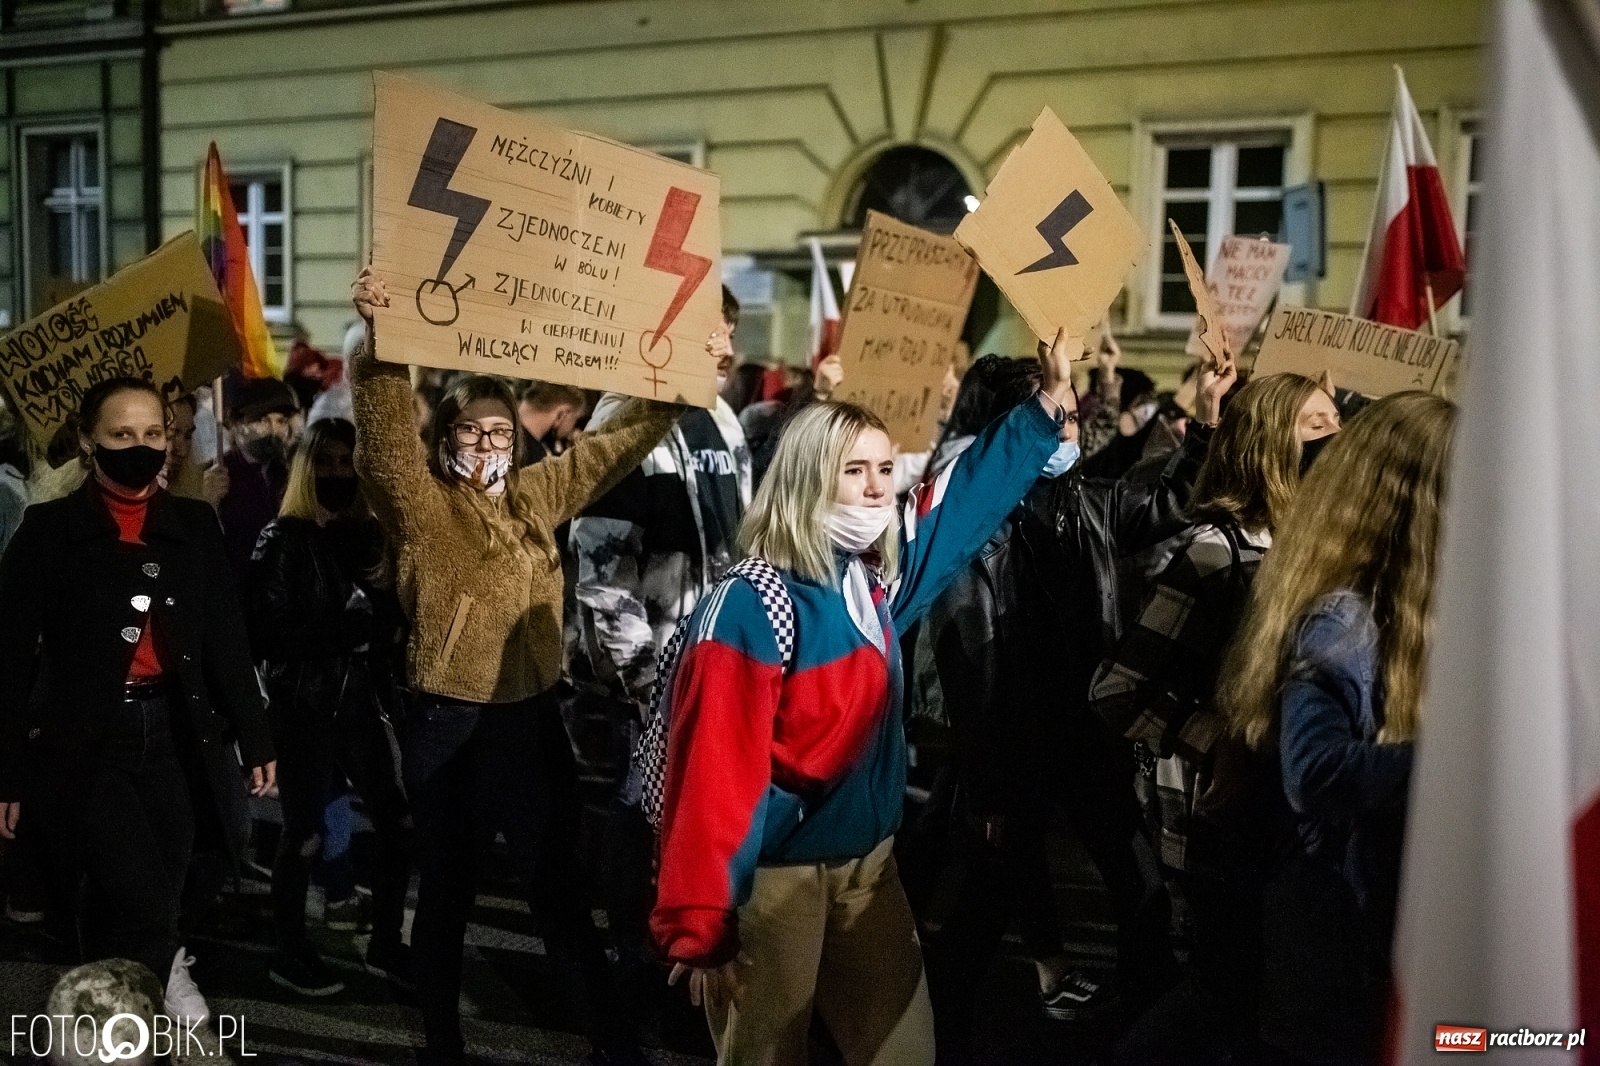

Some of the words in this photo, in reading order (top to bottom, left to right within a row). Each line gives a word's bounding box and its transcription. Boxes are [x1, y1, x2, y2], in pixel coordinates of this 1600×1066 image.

[490, 133, 593, 187] MĘŻCZYŹNI
[587, 191, 648, 226] KOBIETY
[496, 206, 627, 260] ZJEDNOCZENI
[554, 254, 568, 272] W
[493, 271, 617, 321] ZJEDNOCZENI
[457, 331, 539, 366] WALCZĄCY
[520, 318, 533, 335] W
[542, 322, 626, 354] CIERPIENIU!
[13, 343, 94, 402] KOCHAM
